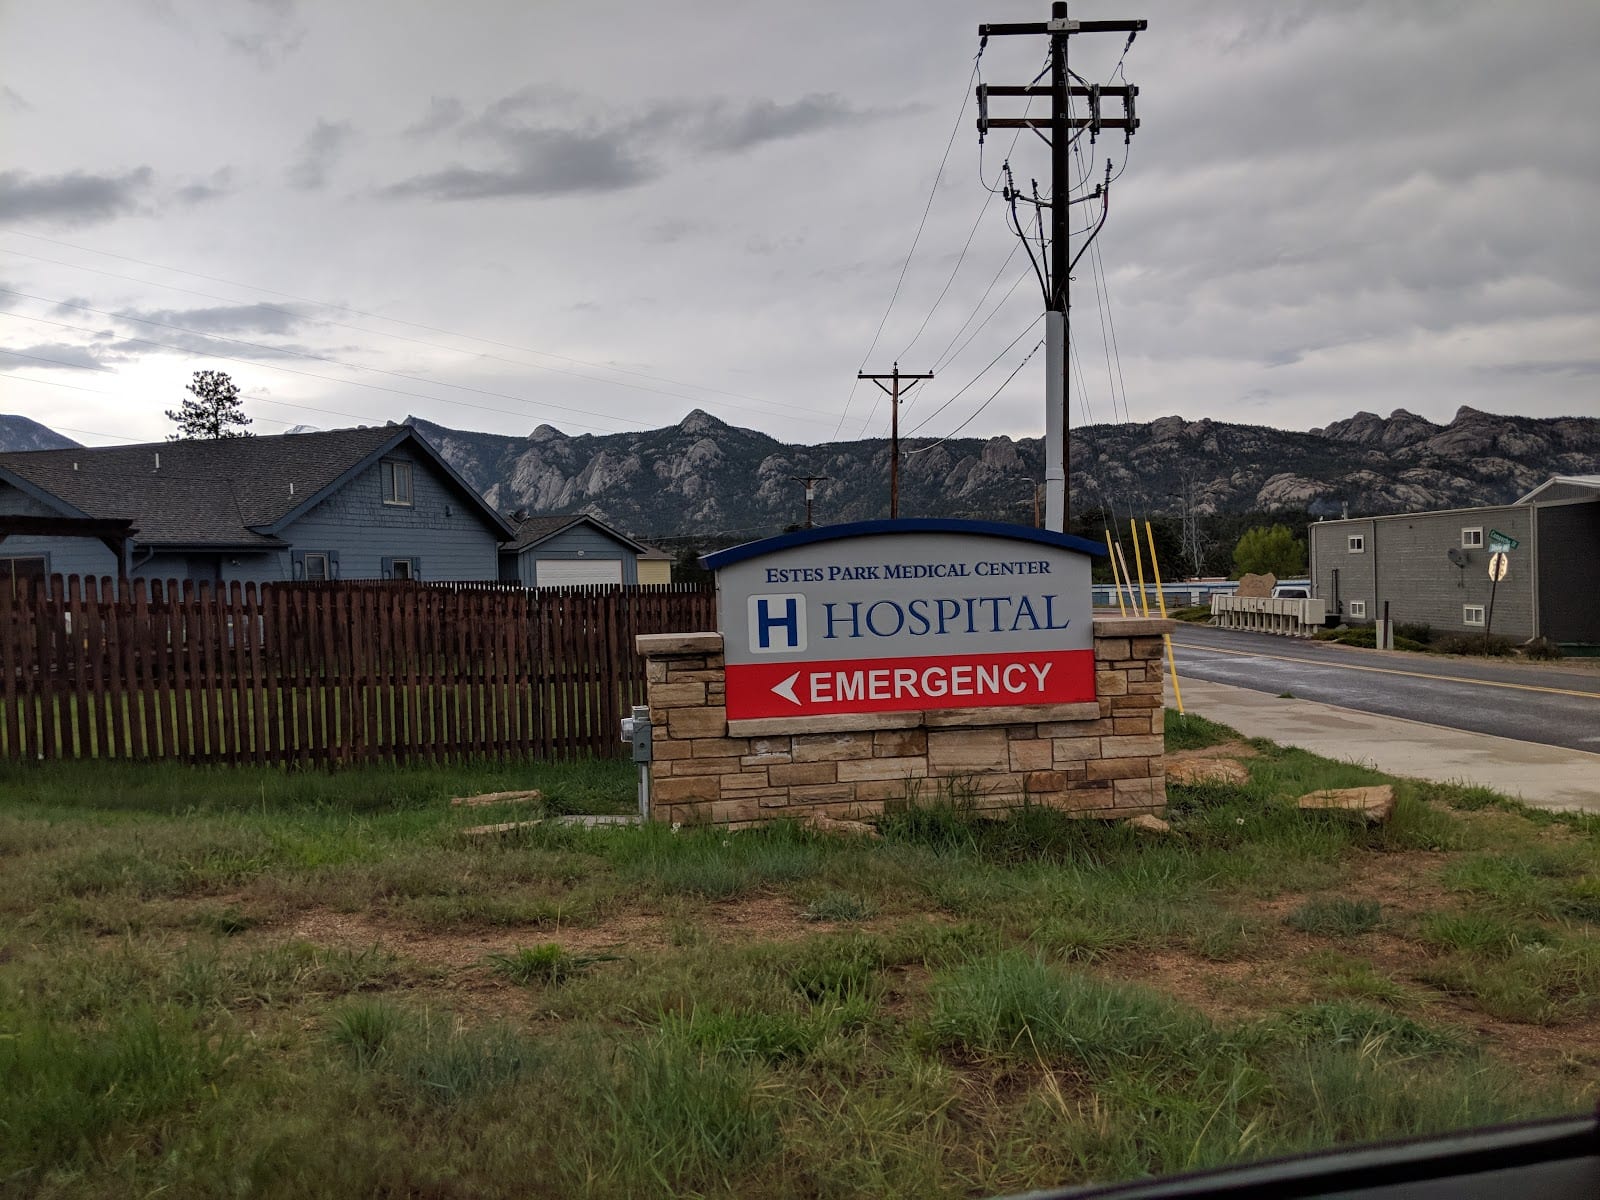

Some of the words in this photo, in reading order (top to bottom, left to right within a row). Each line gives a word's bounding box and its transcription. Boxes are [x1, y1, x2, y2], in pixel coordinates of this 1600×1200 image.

[765, 568, 824, 583] ESTES
[827, 566, 880, 581] PARK
[883, 563, 971, 580] MEDICAL
[975, 561, 1052, 577] CENTER
[757, 598, 798, 648] H
[822, 595, 1070, 639] HOSPITAL
[809, 662, 1053, 703] EMERGENCY
